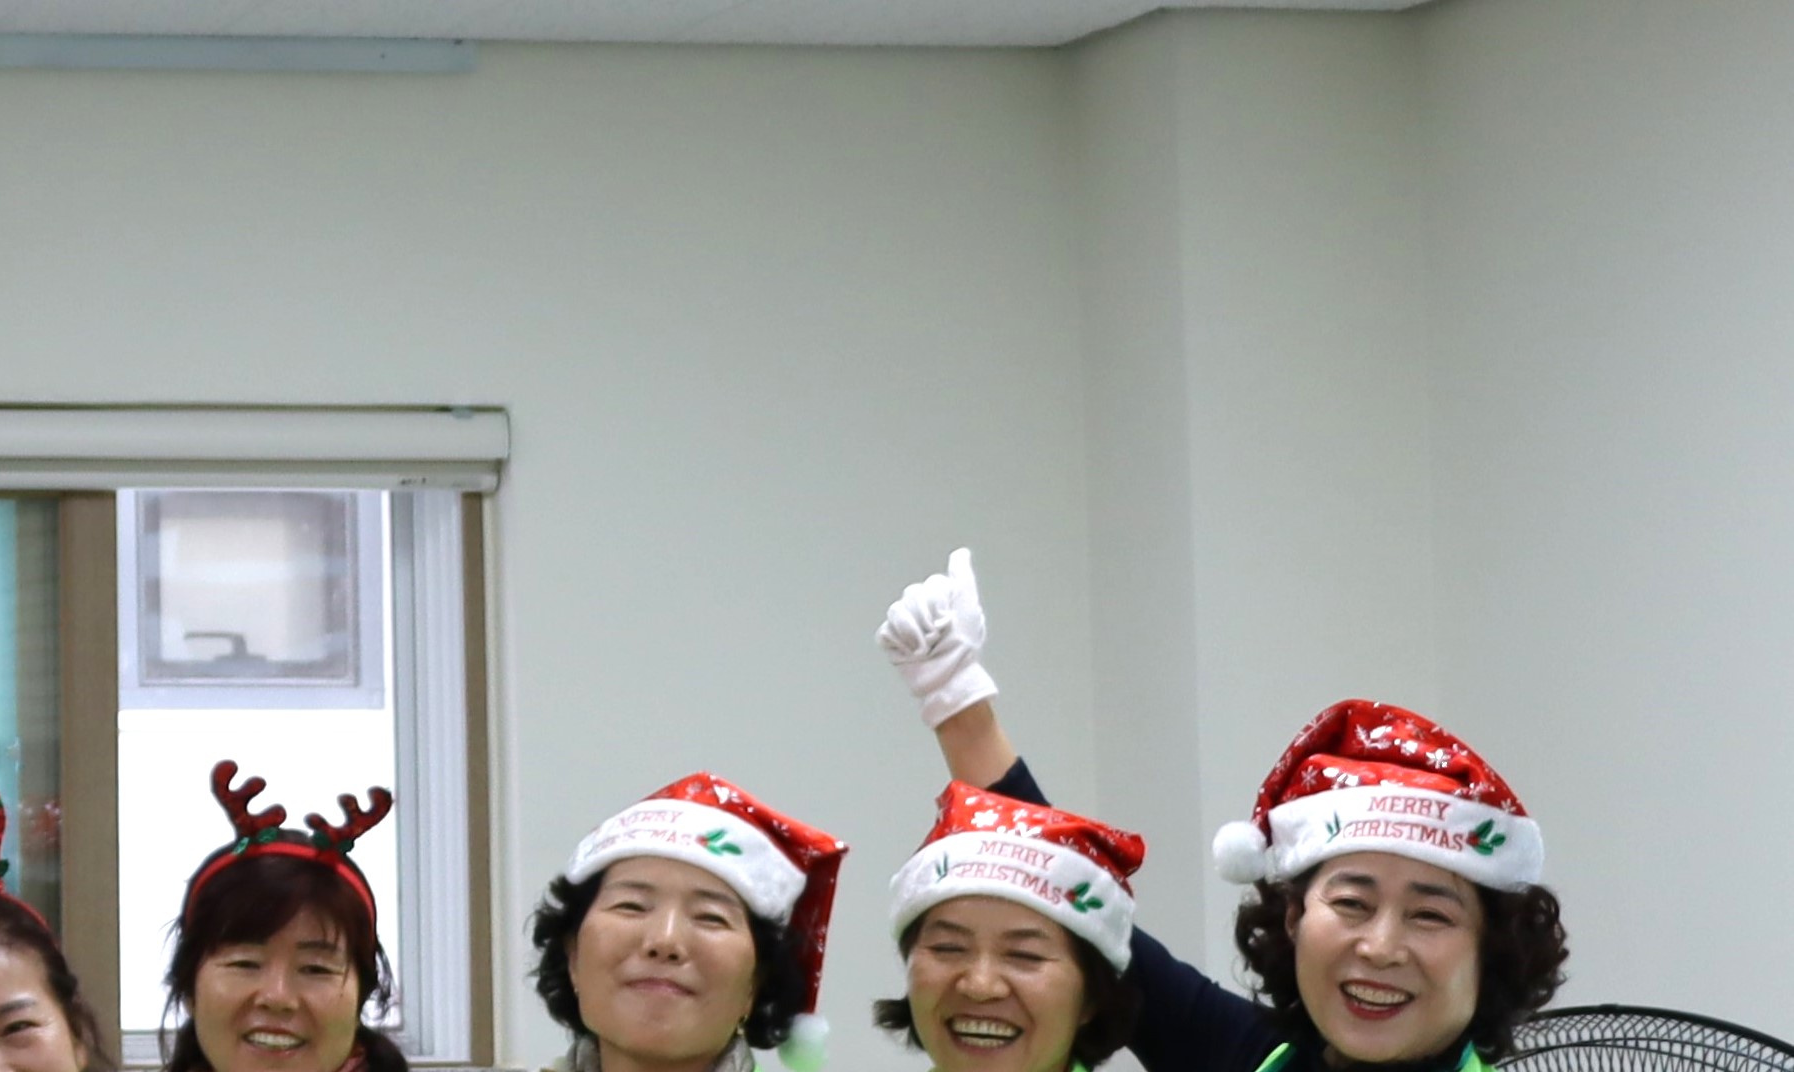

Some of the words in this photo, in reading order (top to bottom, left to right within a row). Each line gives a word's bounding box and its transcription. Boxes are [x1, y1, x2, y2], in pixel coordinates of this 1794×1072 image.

[1367, 795, 1451, 821] MERRY
[1342, 819, 1463, 852] CHRISTMAS
[977, 840, 1055, 871] MERRY
